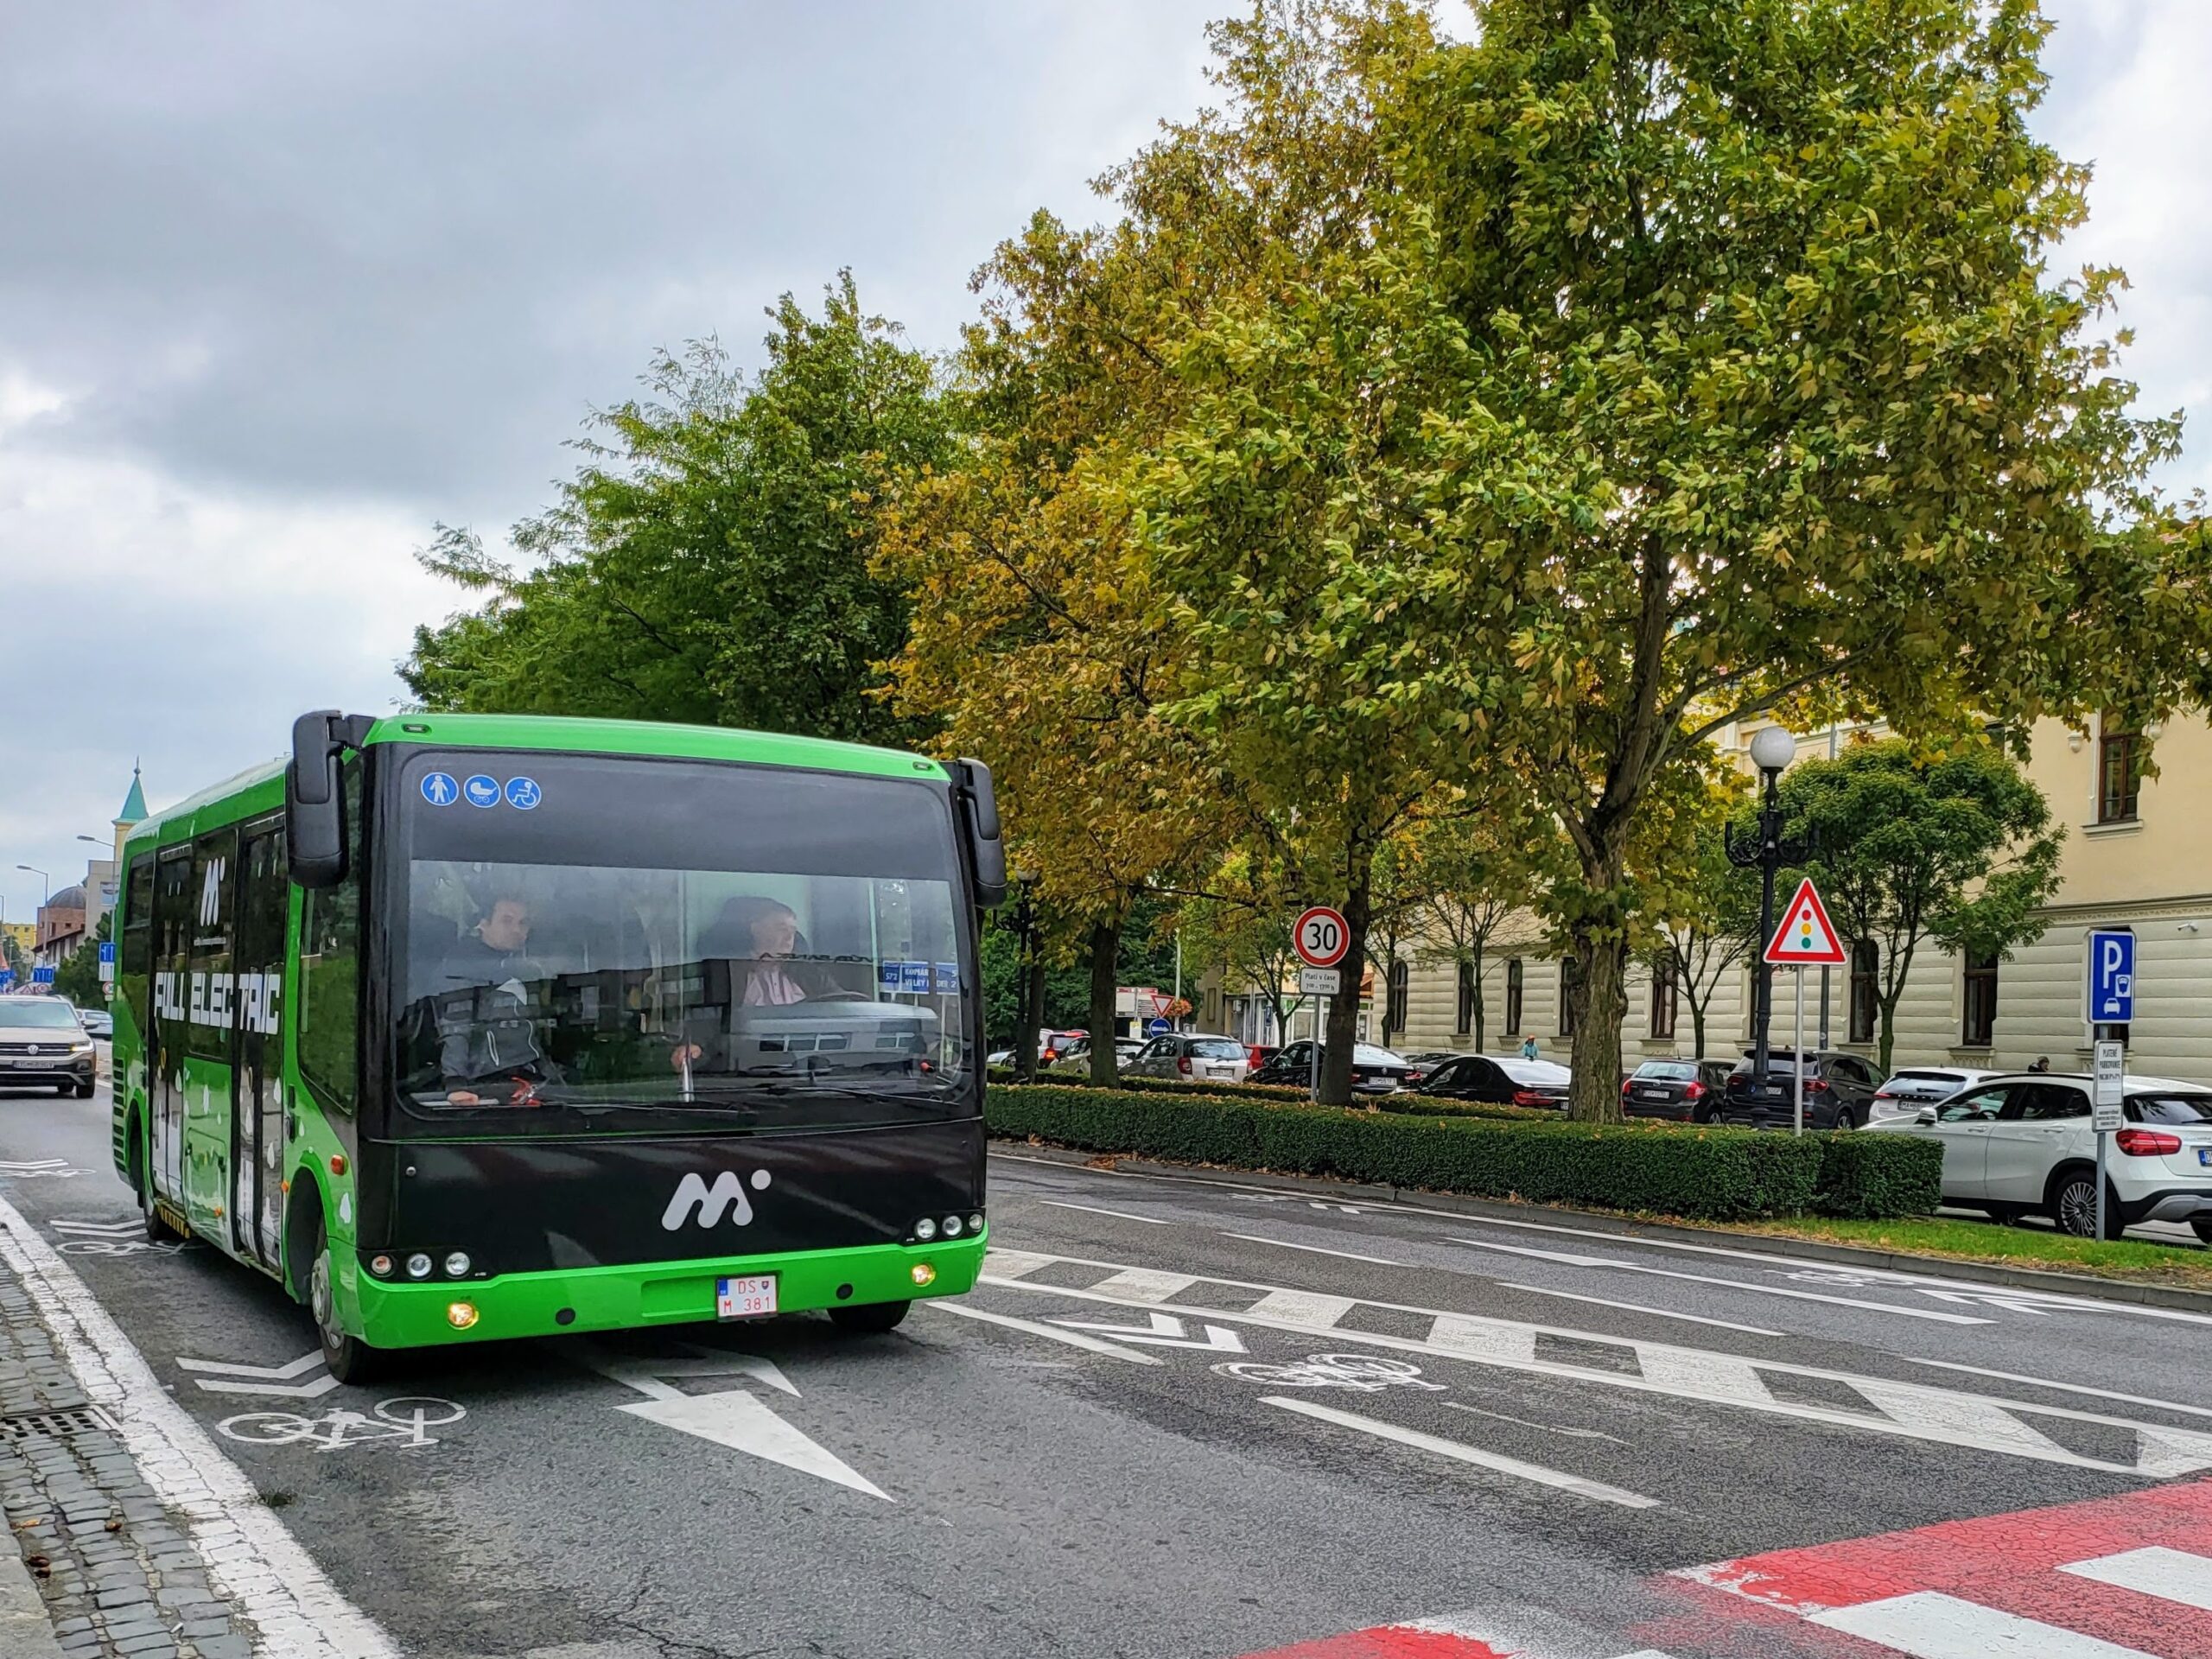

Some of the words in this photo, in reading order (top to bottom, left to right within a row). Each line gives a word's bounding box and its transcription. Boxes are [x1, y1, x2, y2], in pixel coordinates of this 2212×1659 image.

[1307, 923, 1338, 950] 30
[2102, 940, 2123, 989] P
[1324, 973, 1336, 982] čase
[154, 972, 186, 1021] FULL
[738, 1280, 756, 1294] DS
[723, 1300, 733, 1313] M
[744, 1296, 770, 1312] 381
